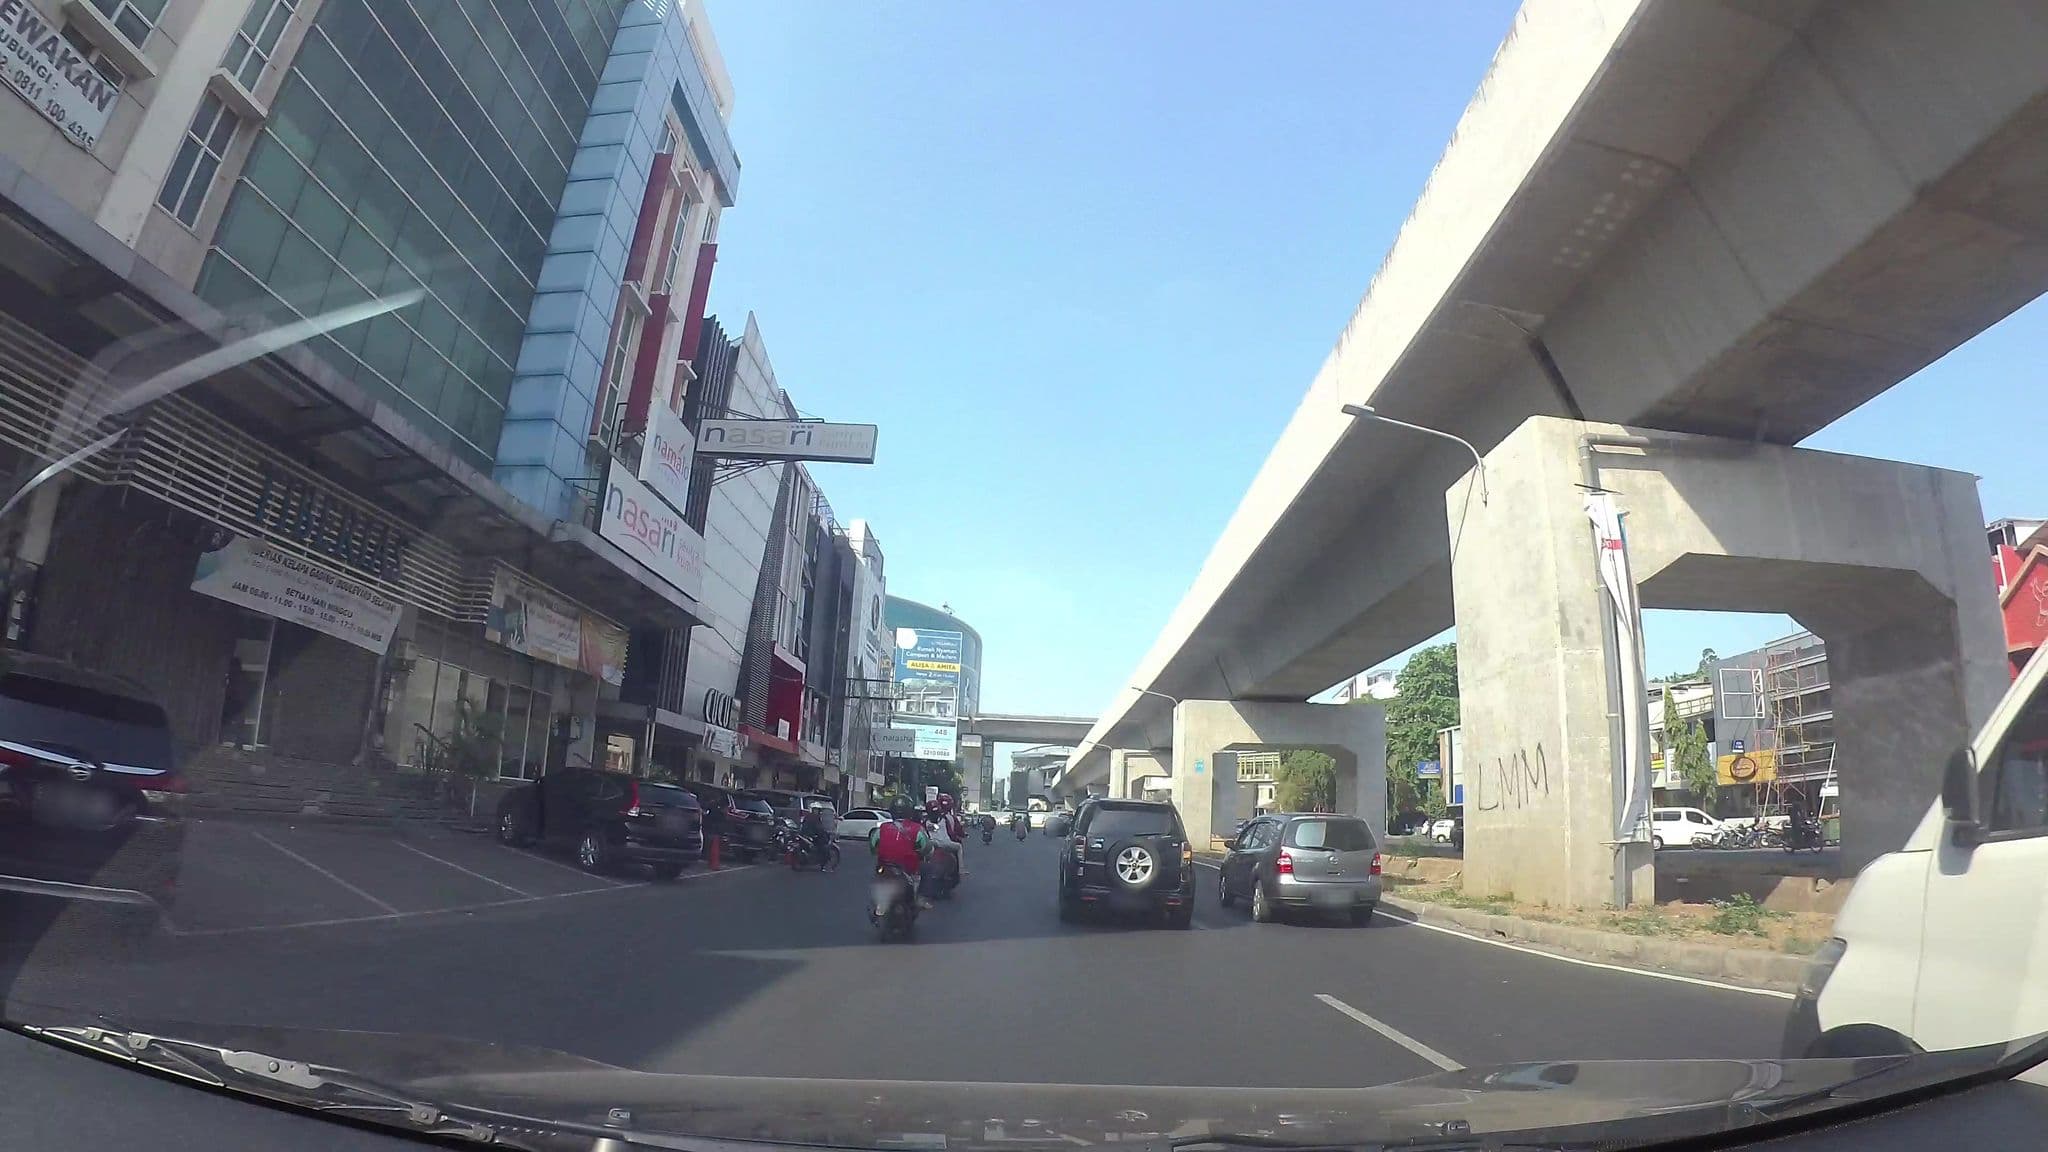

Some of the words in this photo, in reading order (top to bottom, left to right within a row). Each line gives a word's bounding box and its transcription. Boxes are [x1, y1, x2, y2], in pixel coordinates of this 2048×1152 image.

[45, 98, 66, 122] 100
[704, 424, 815, 447] nasari
[606, 482, 678, 558] nasari
